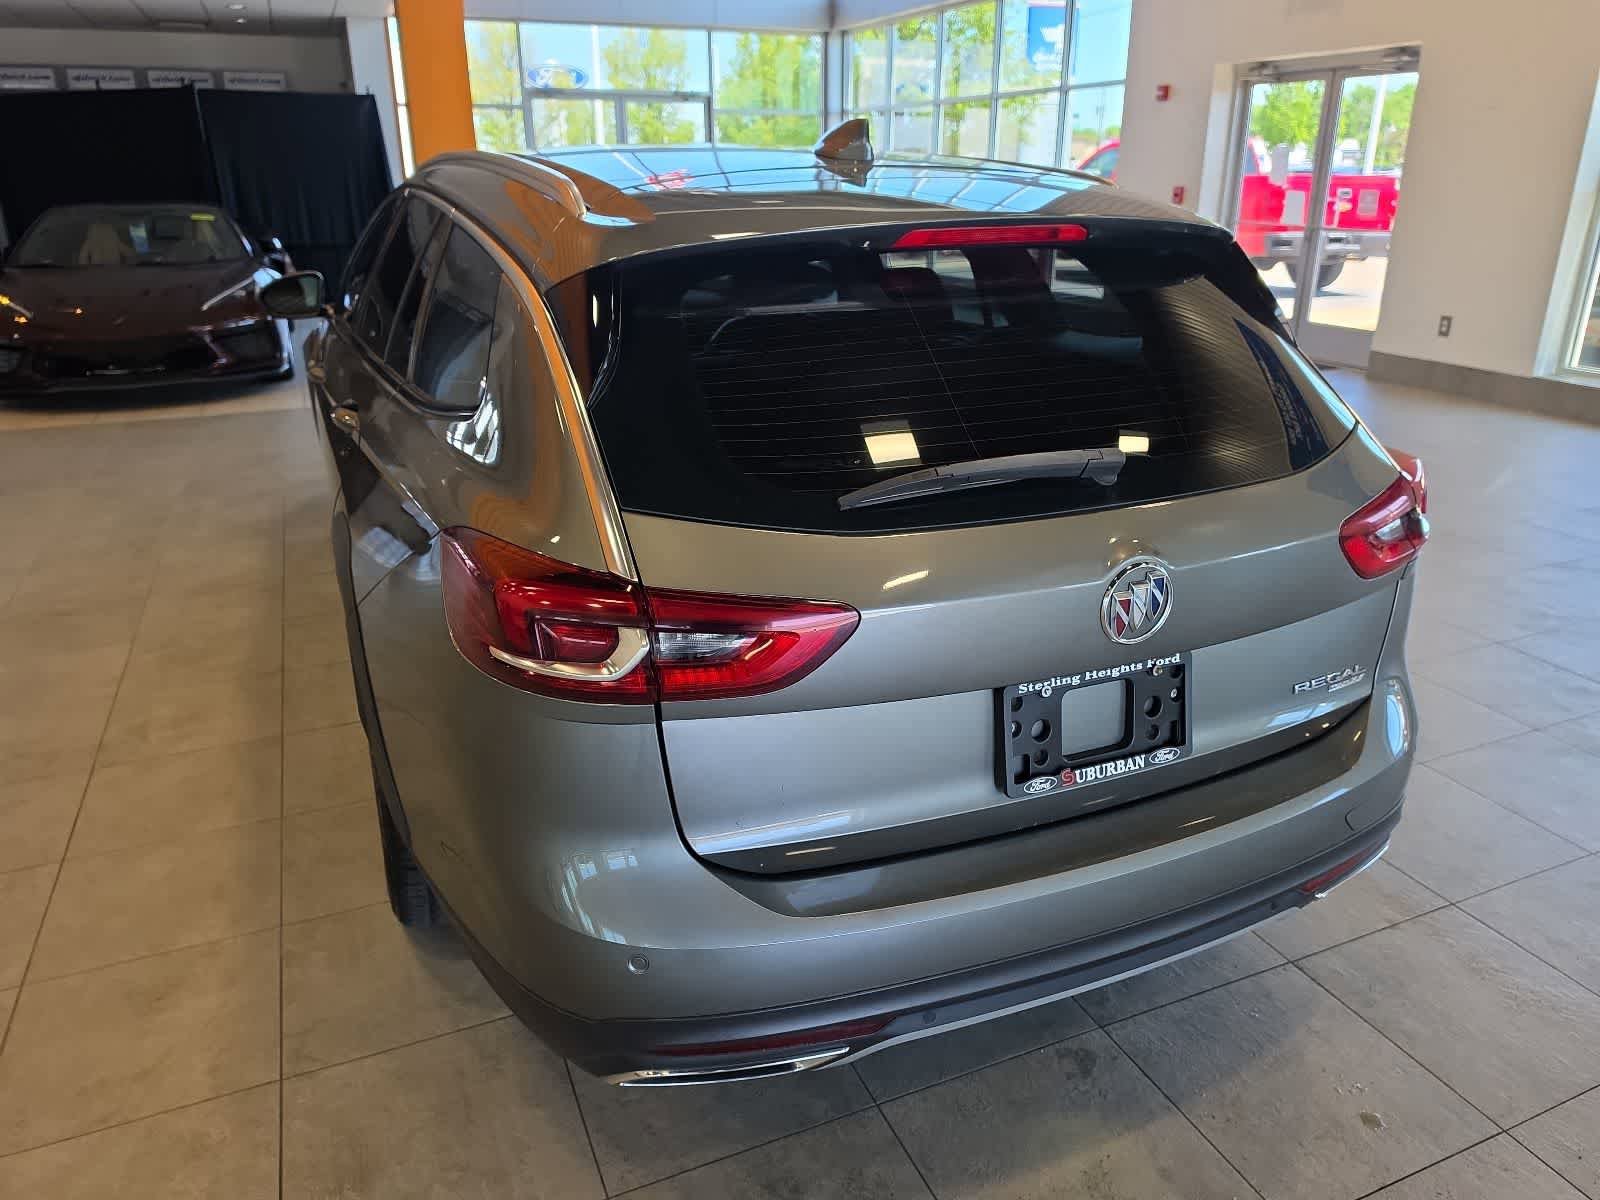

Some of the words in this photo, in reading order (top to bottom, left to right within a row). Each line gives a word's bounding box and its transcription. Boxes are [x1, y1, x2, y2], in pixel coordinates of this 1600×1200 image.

[1018, 674, 1080, 694] Sterling
[1085, 662, 1143, 681] Heights
[1147, 653, 1181, 669] Ford
[1293, 665, 1366, 694] REGAL
[1061, 755, 1146, 787] SUBURBAN
